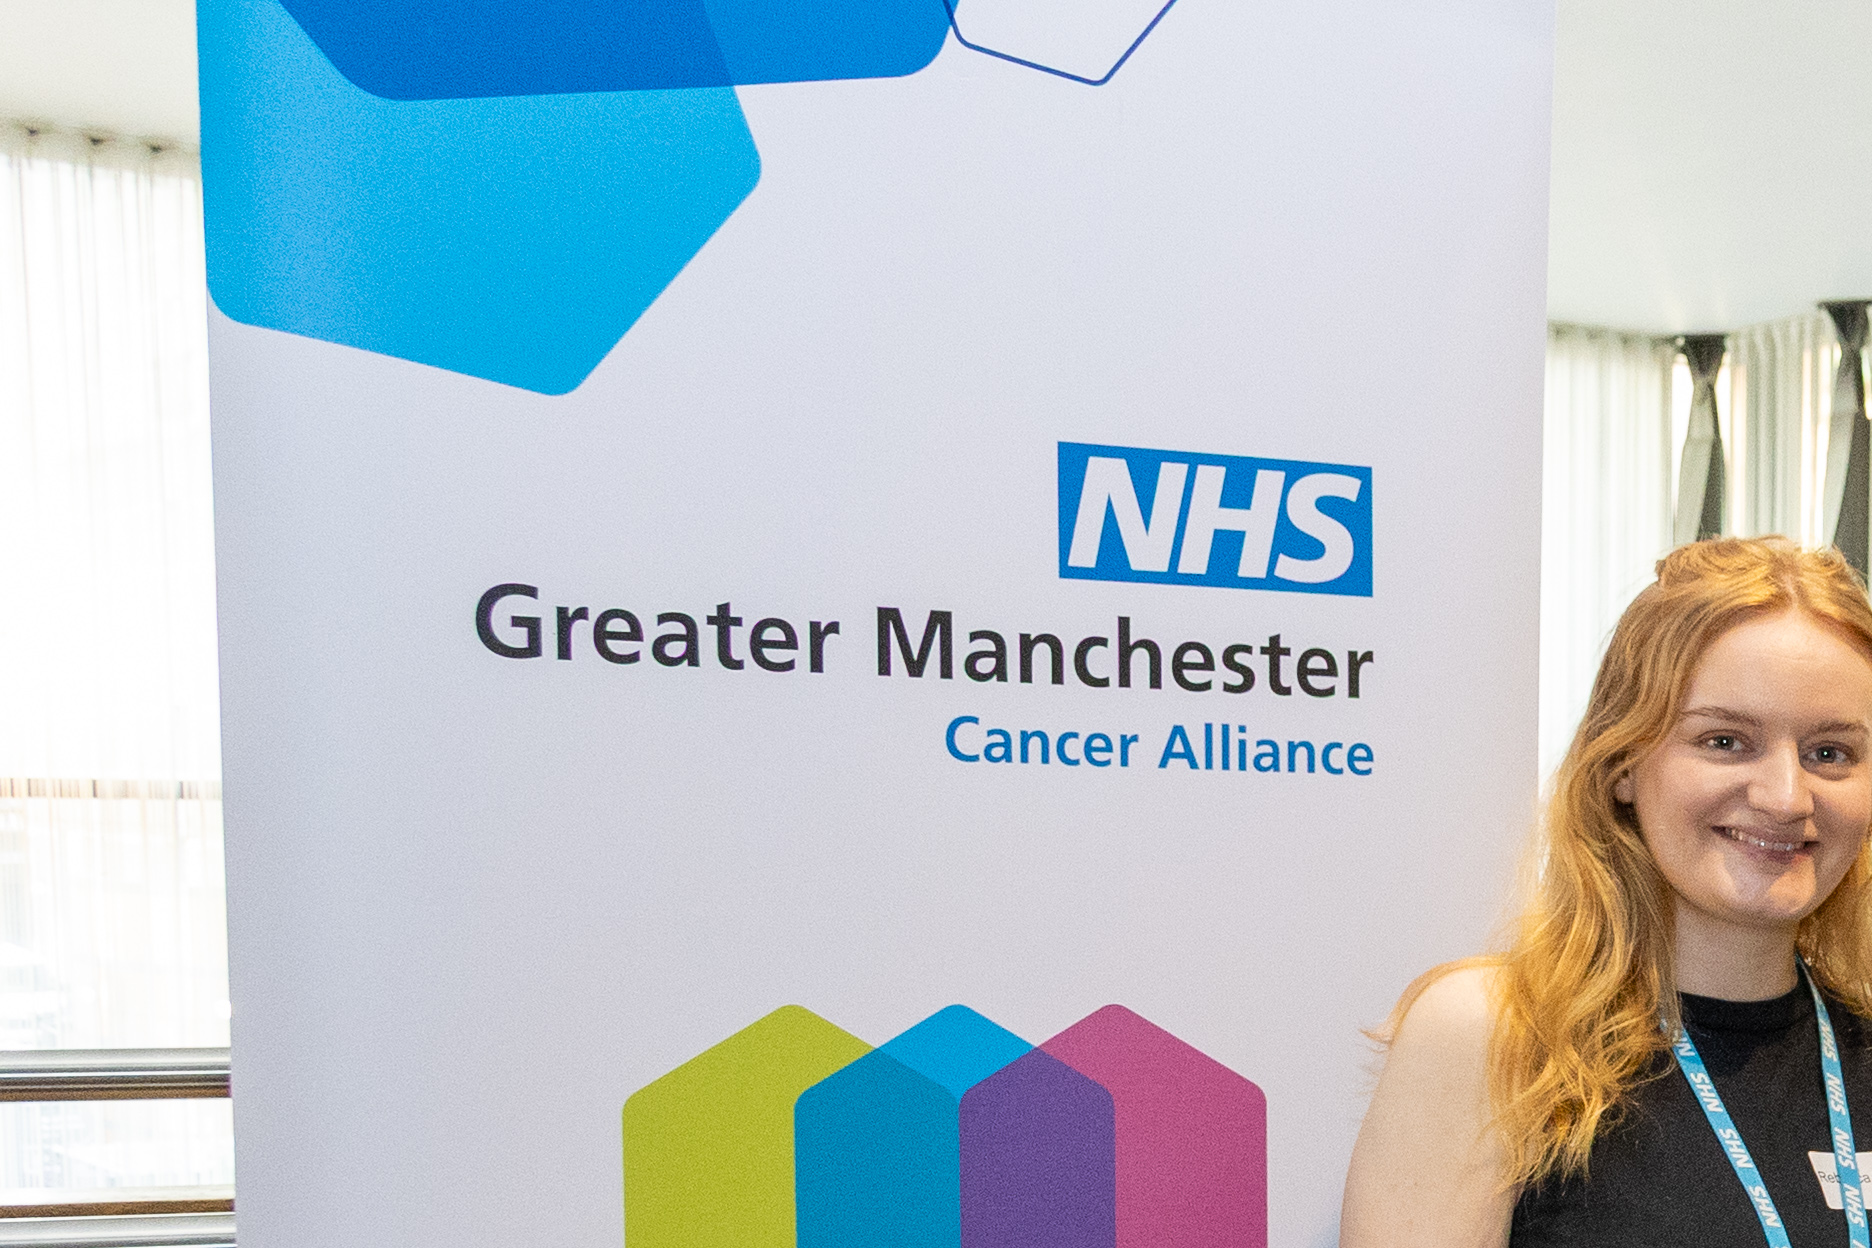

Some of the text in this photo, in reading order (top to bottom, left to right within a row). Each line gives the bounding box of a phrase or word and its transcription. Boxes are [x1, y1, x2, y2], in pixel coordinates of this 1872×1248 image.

[1068, 456, 1361, 582] NHS
[475, 582, 1375, 700] Greater Manchester
[945, 716, 1376, 778] Cancer Alliance
[1691, 1072, 1723, 1113] NHS
[1824, 1072, 1847, 1116] NHS
[1719, 1128, 1753, 1168] NHS
[1831, 1127, 1855, 1170] NHS
[1749, 1185, 1781, 1228] NHS
[1843, 1183, 1865, 1228] NHS
